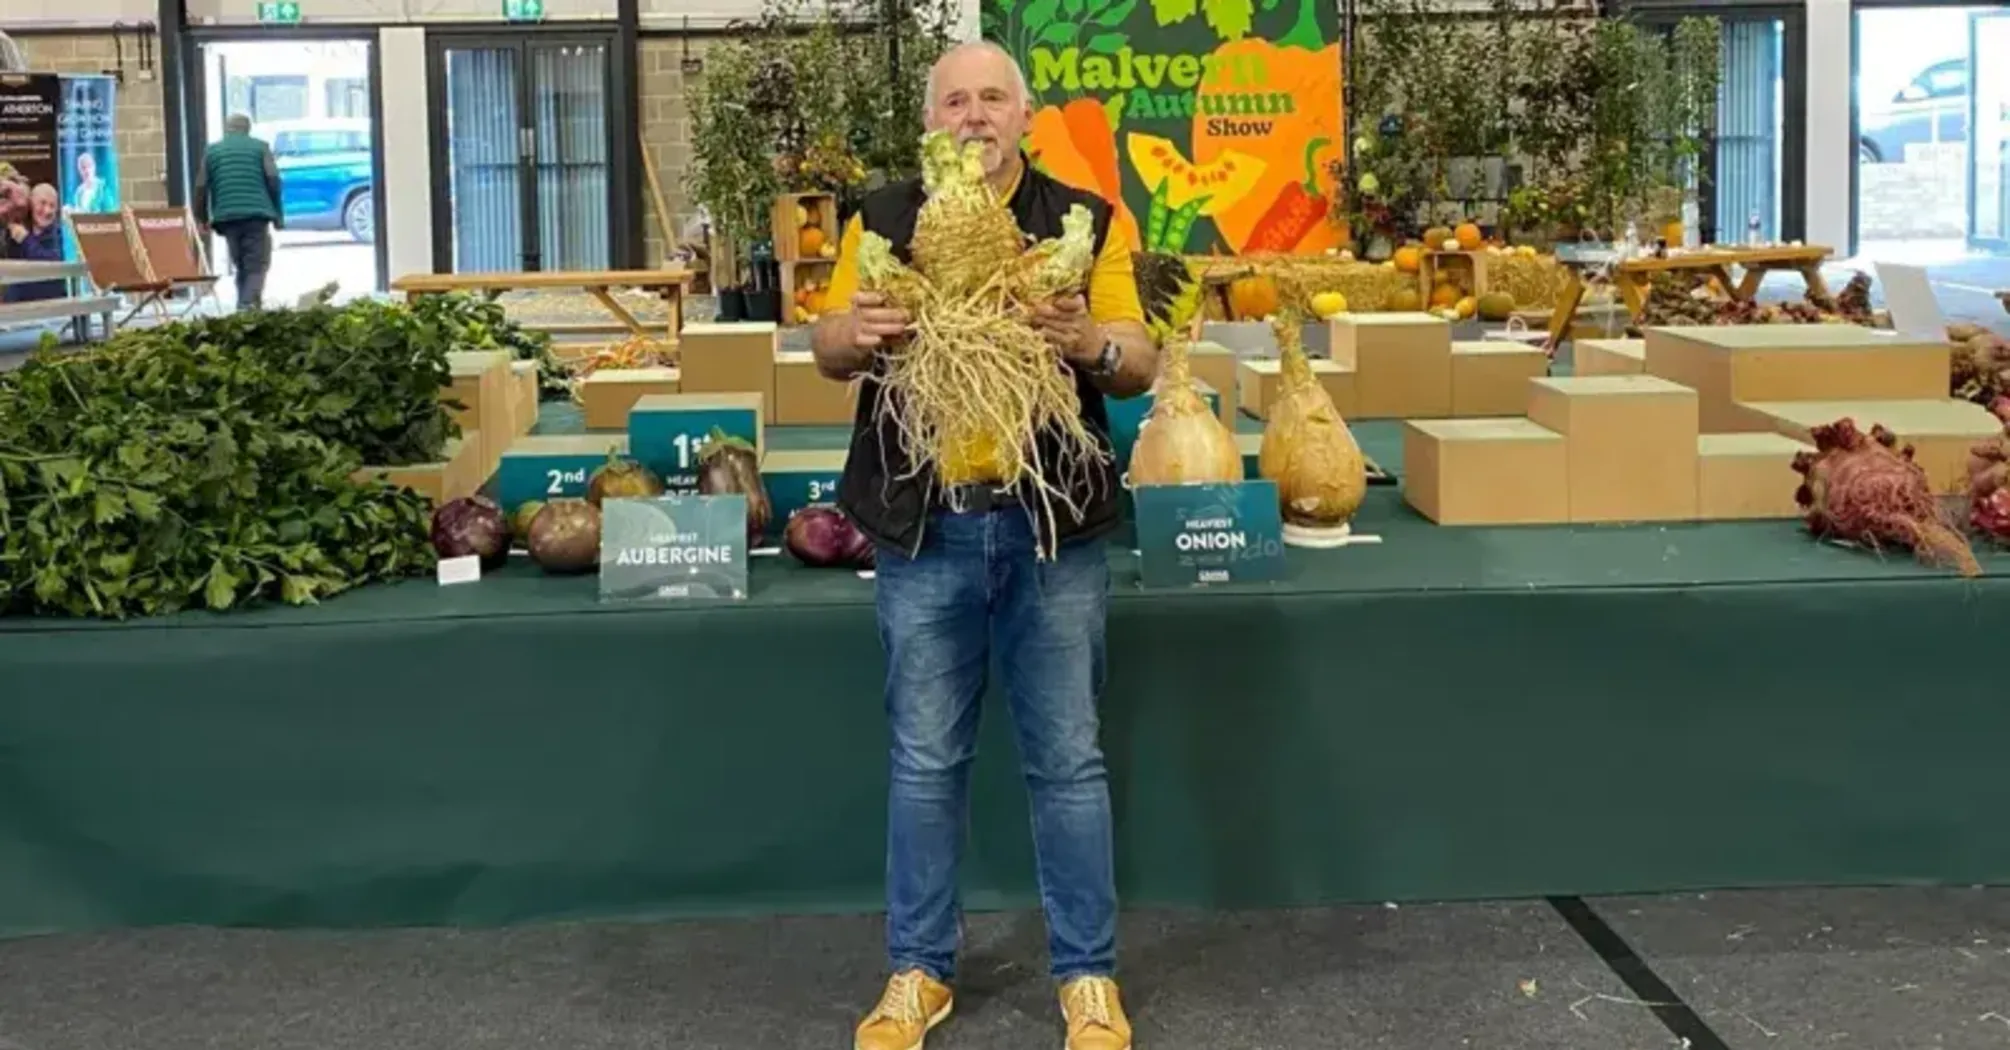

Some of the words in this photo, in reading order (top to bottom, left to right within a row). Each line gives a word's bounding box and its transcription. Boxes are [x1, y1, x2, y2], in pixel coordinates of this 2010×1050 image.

[1031, 47, 1268, 90] Malvern
[1126, 88, 1296, 119] Autumn
[1206, 118, 1274, 137] Show
[547, 467, 585, 493] 2nd
[808, 480, 835, 500] 3rd
[1175, 531, 1246, 551] ONION
[616, 545, 732, 566] AUBERGINE
